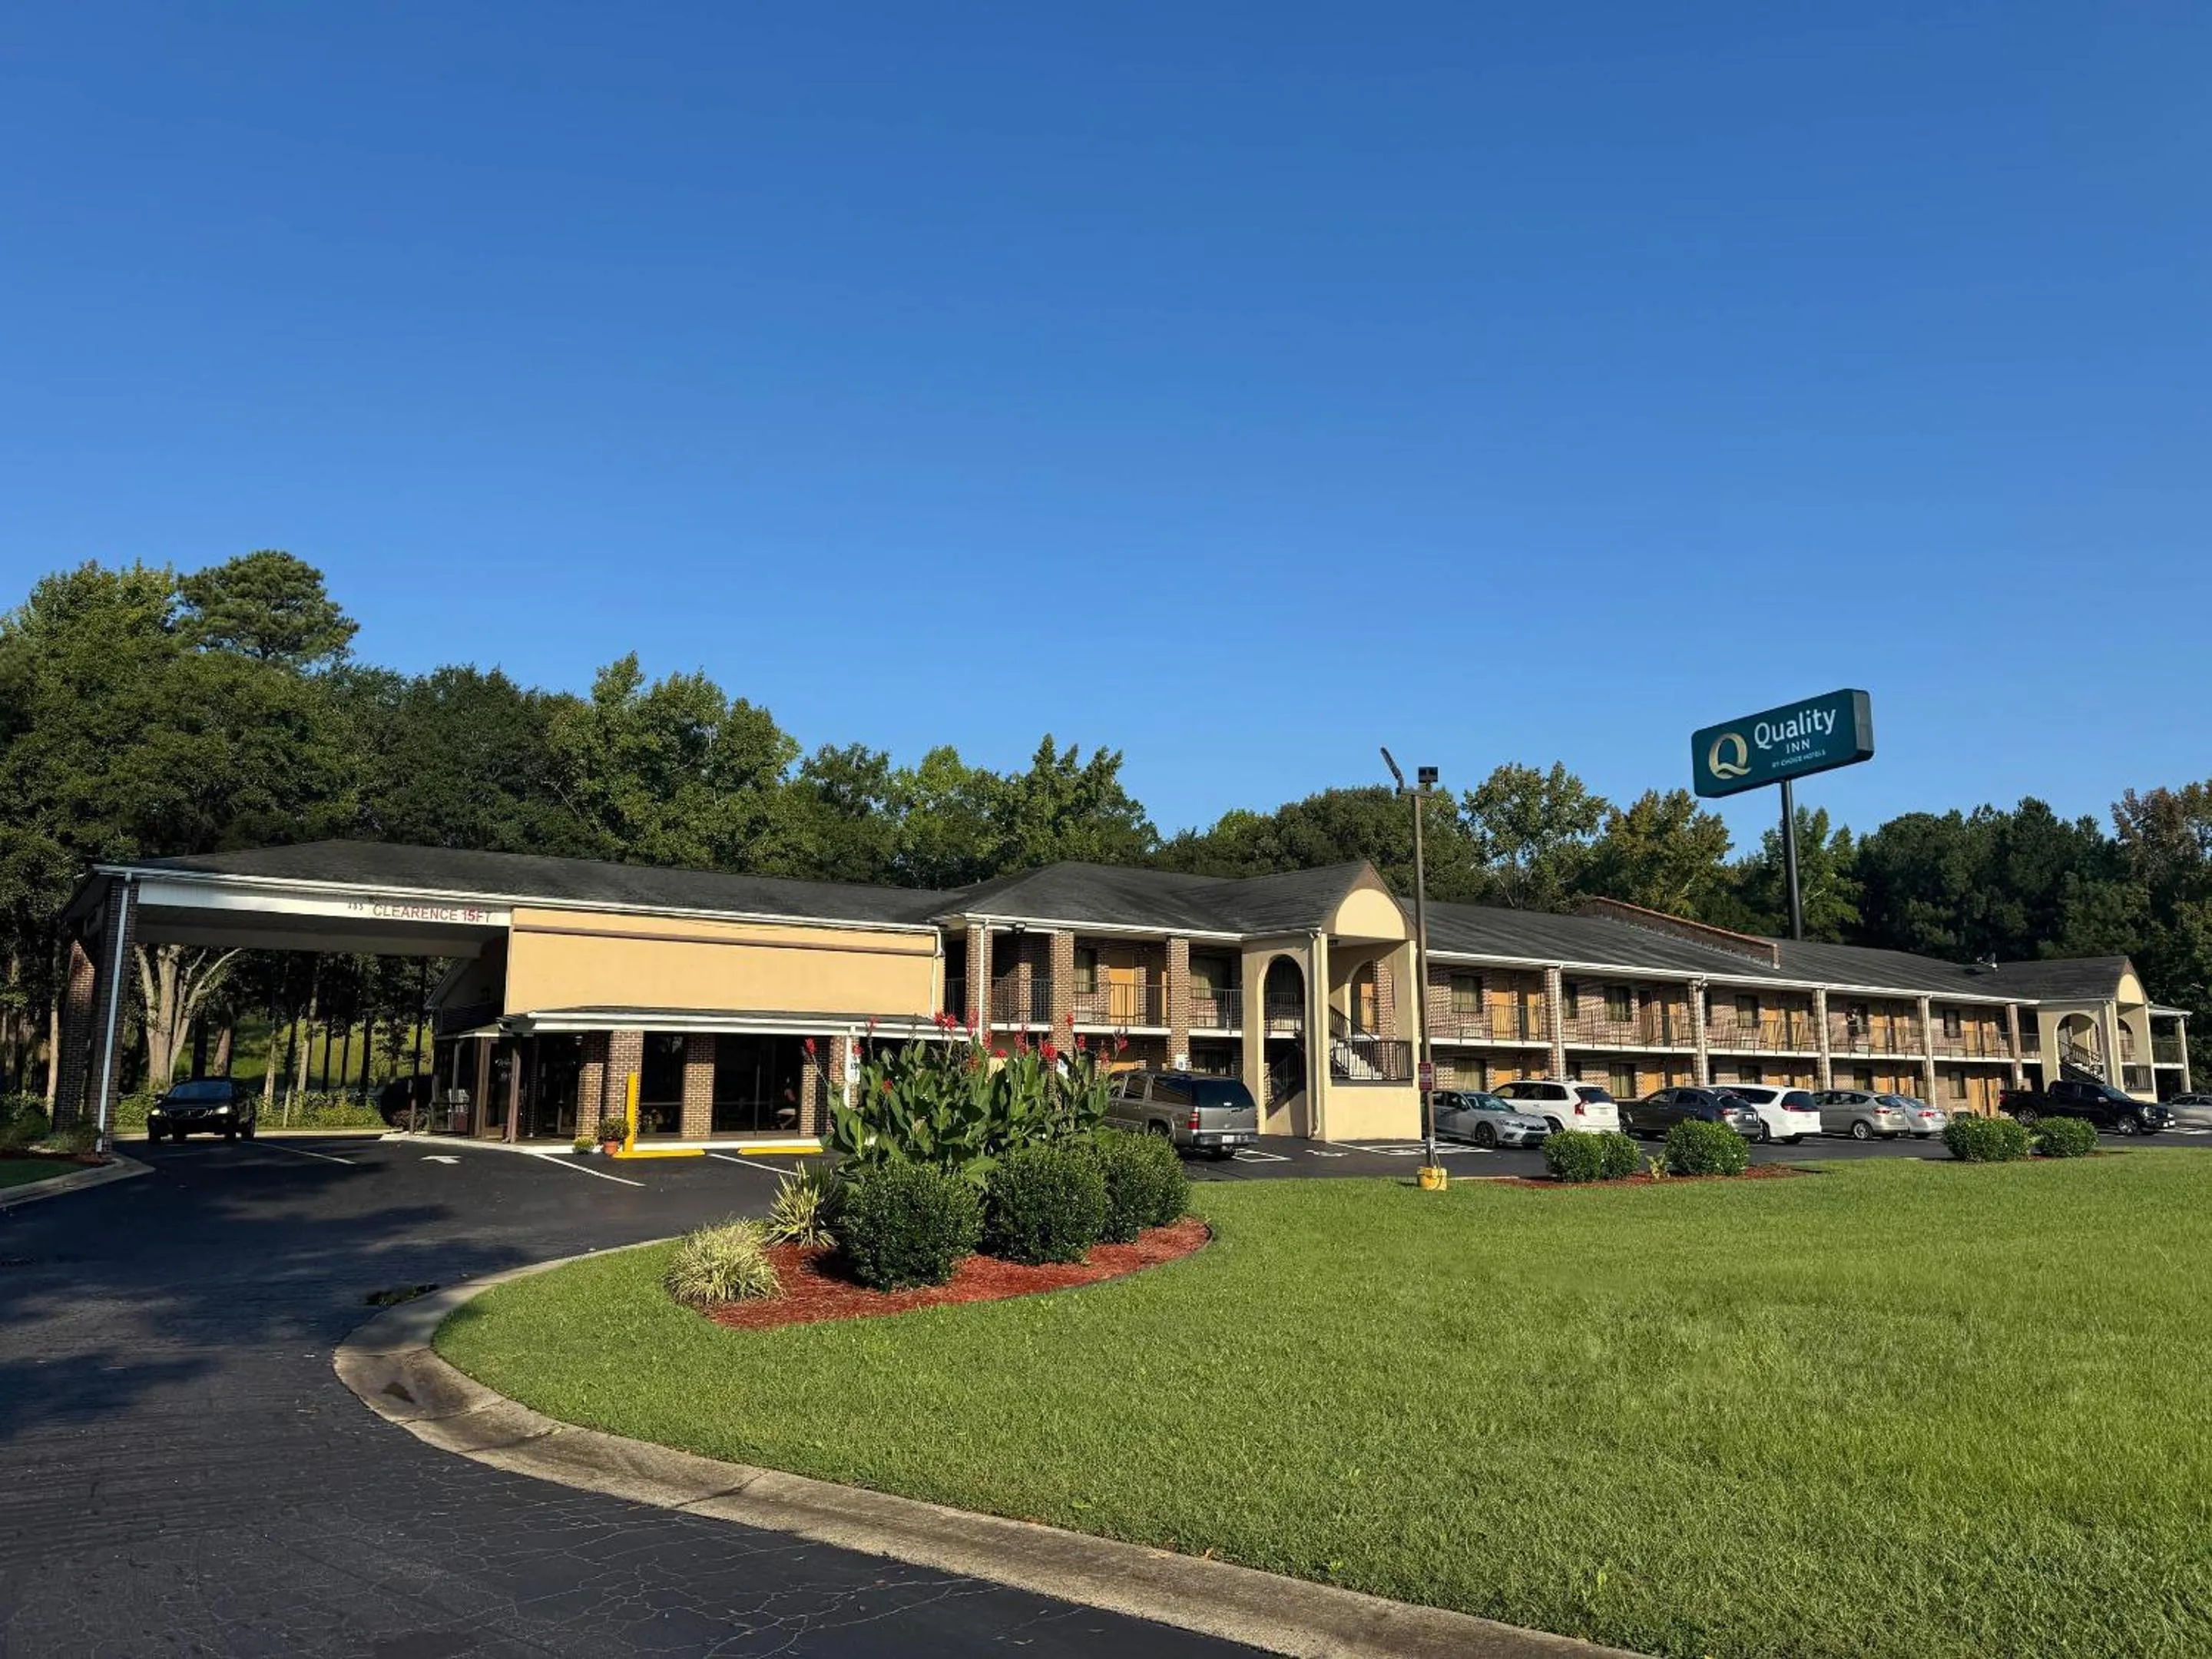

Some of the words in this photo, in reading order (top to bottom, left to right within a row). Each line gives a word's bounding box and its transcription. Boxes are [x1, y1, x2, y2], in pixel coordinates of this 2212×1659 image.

[1754, 709, 1836, 750] Quality
[1709, 733, 1751, 780] Q
[1786, 738, 1810, 753] INN
[373, 903, 457, 921] CLEARENCE
